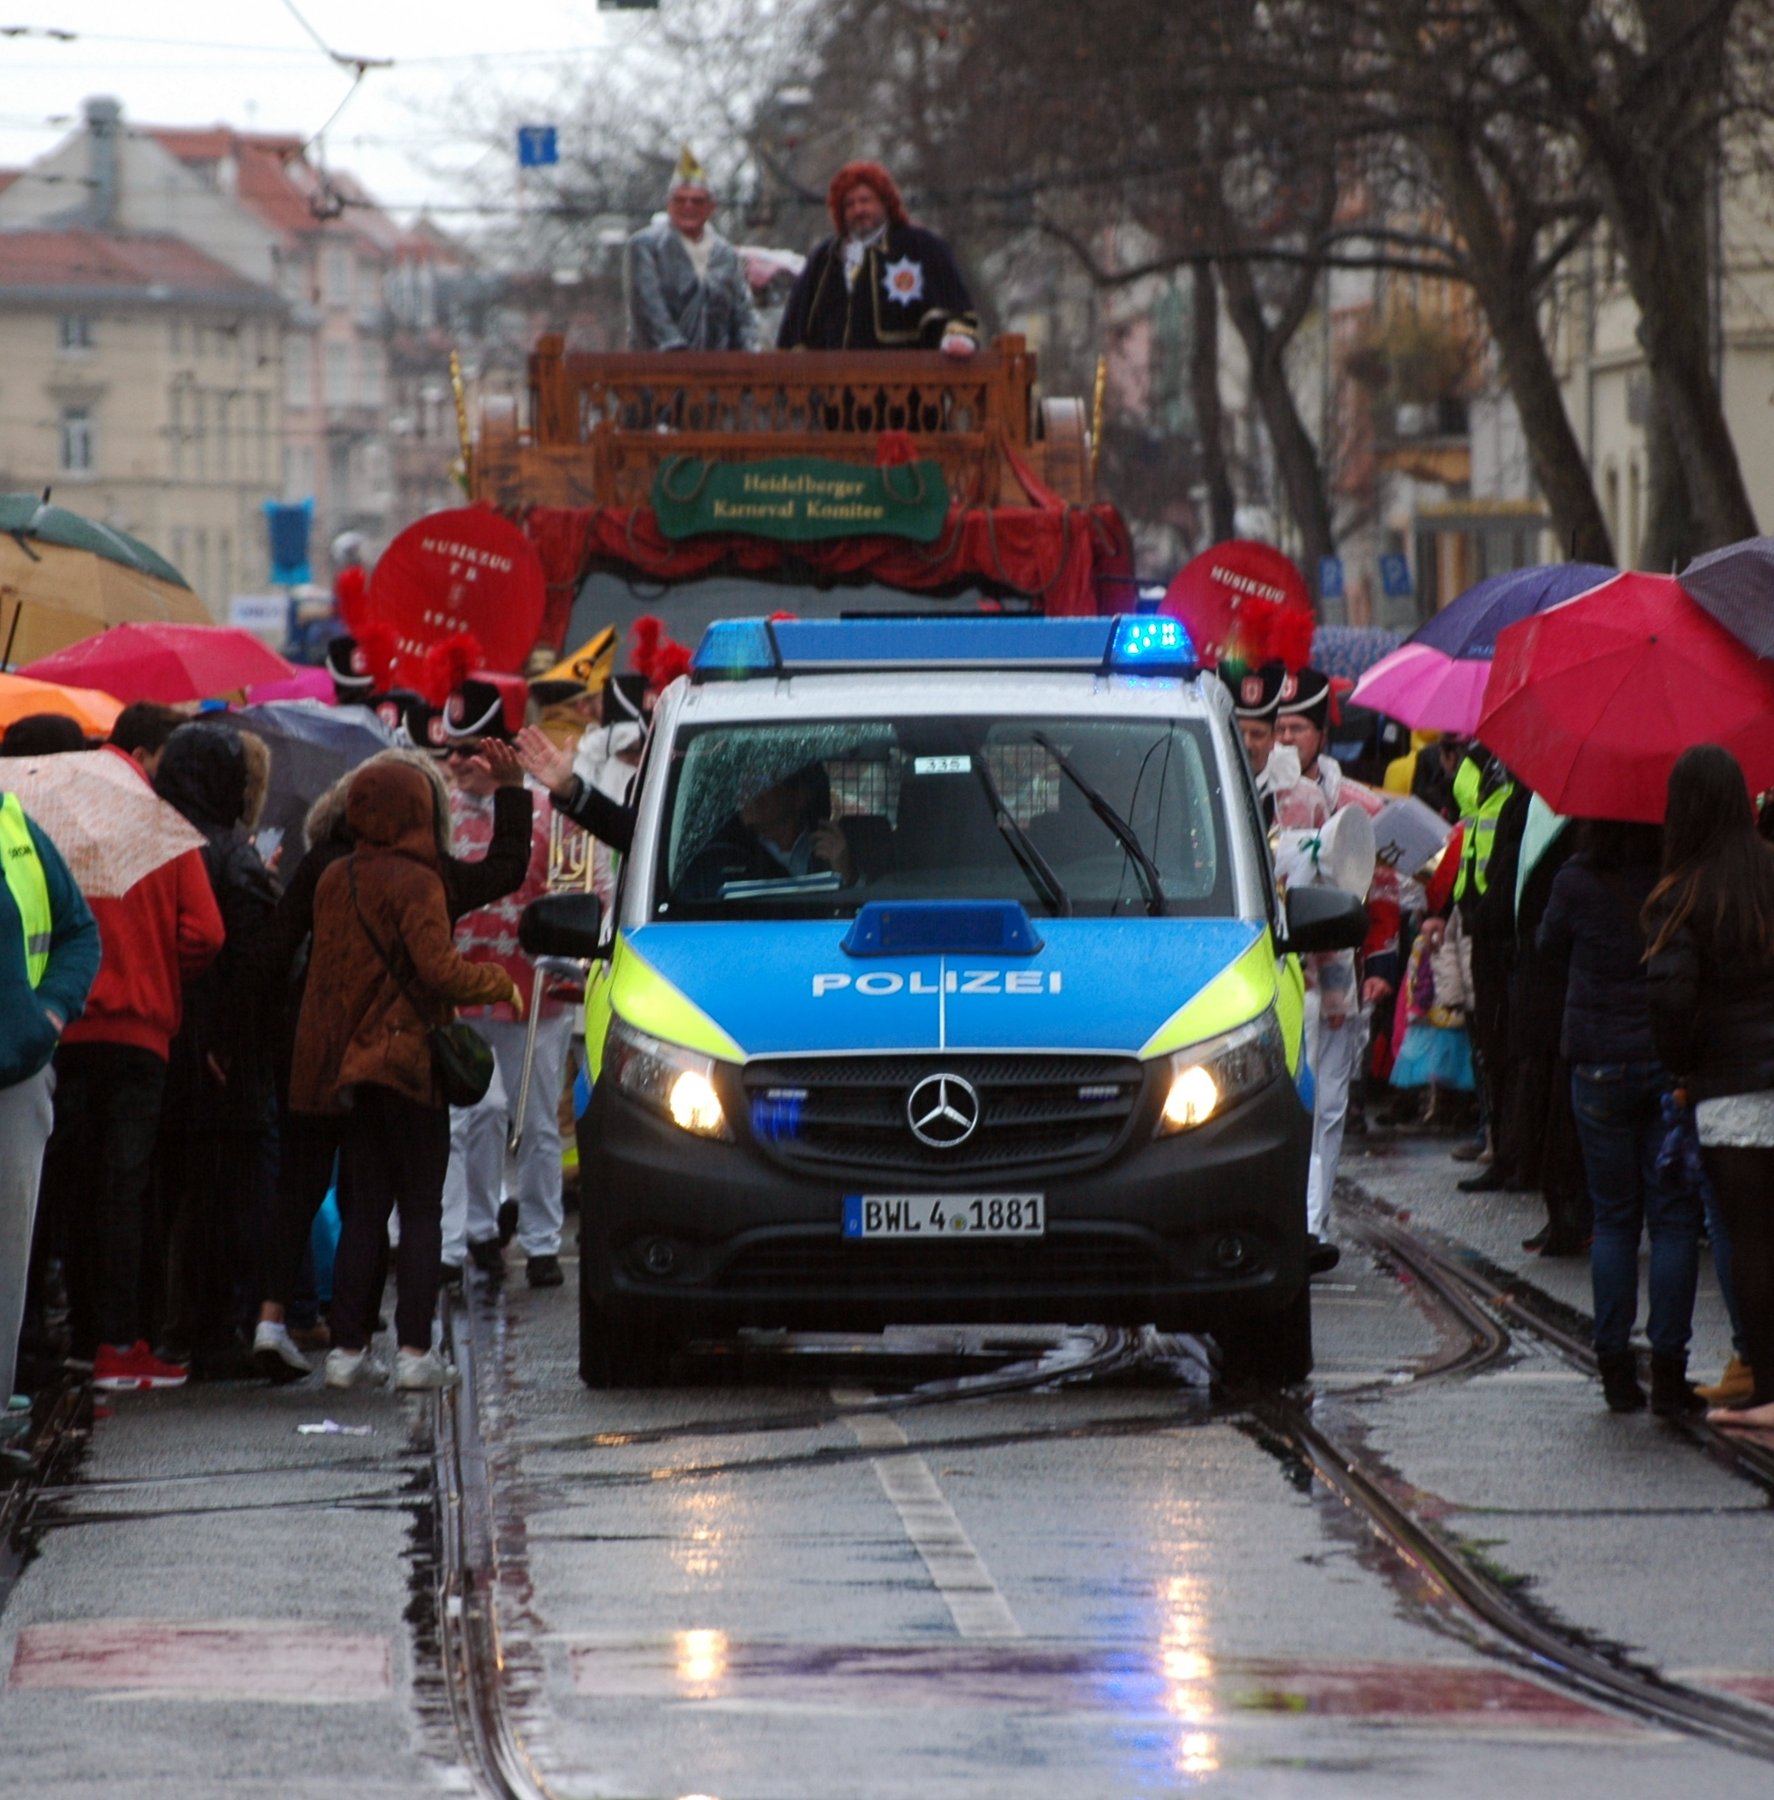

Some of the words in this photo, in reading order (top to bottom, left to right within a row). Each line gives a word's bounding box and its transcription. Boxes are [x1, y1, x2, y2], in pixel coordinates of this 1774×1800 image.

[743, 473, 865, 498] Heidelberger
[714, 500, 795, 518] Karneval
[807, 501, 885, 519] Komitee
[421, 537, 512, 573] MUSIKZUG
[1211, 565, 1287, 604] MUSIKZUG
[812, 970, 1062, 998] POLIZEI
[865, 1200, 921, 1232] BWL
[929, 1200, 945, 1231] 4
[969, 1199, 1041, 1231] 1881
